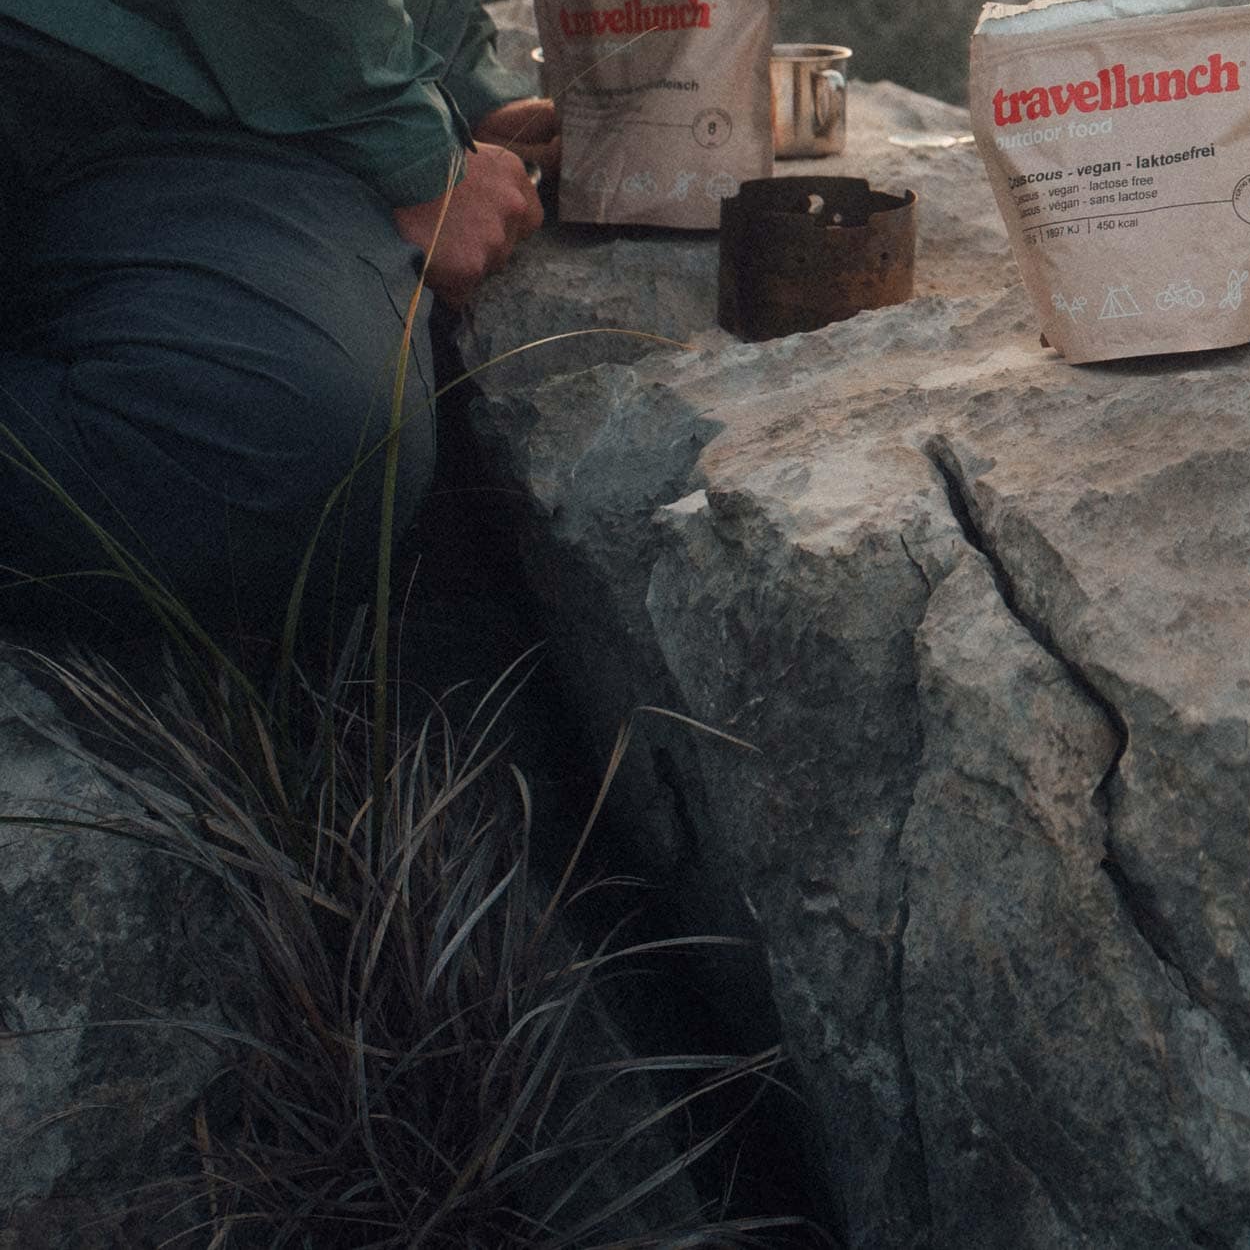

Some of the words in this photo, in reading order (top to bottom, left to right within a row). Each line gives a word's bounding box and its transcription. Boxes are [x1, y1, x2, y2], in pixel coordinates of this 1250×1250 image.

[992, 53, 1240, 125] travellunch
[996, 125, 1062, 151] outdoor
[1067, 117, 1114, 138] food
[1077, 161, 1121, 177] vegan
[1136, 143, 1216, 169] laktosefrei
[1048, 183, 1079, 198] vegan
[1089, 177, 1128, 191] lactose
[1131, 175, 1154, 186] free
[1089, 194, 1115, 206] sans
[1118, 189, 1158, 203] lactose
[1067, 225, 1080, 236] KJ
[1096, 220, 1115, 231] 450
[1117, 218, 1138, 229] kcal
